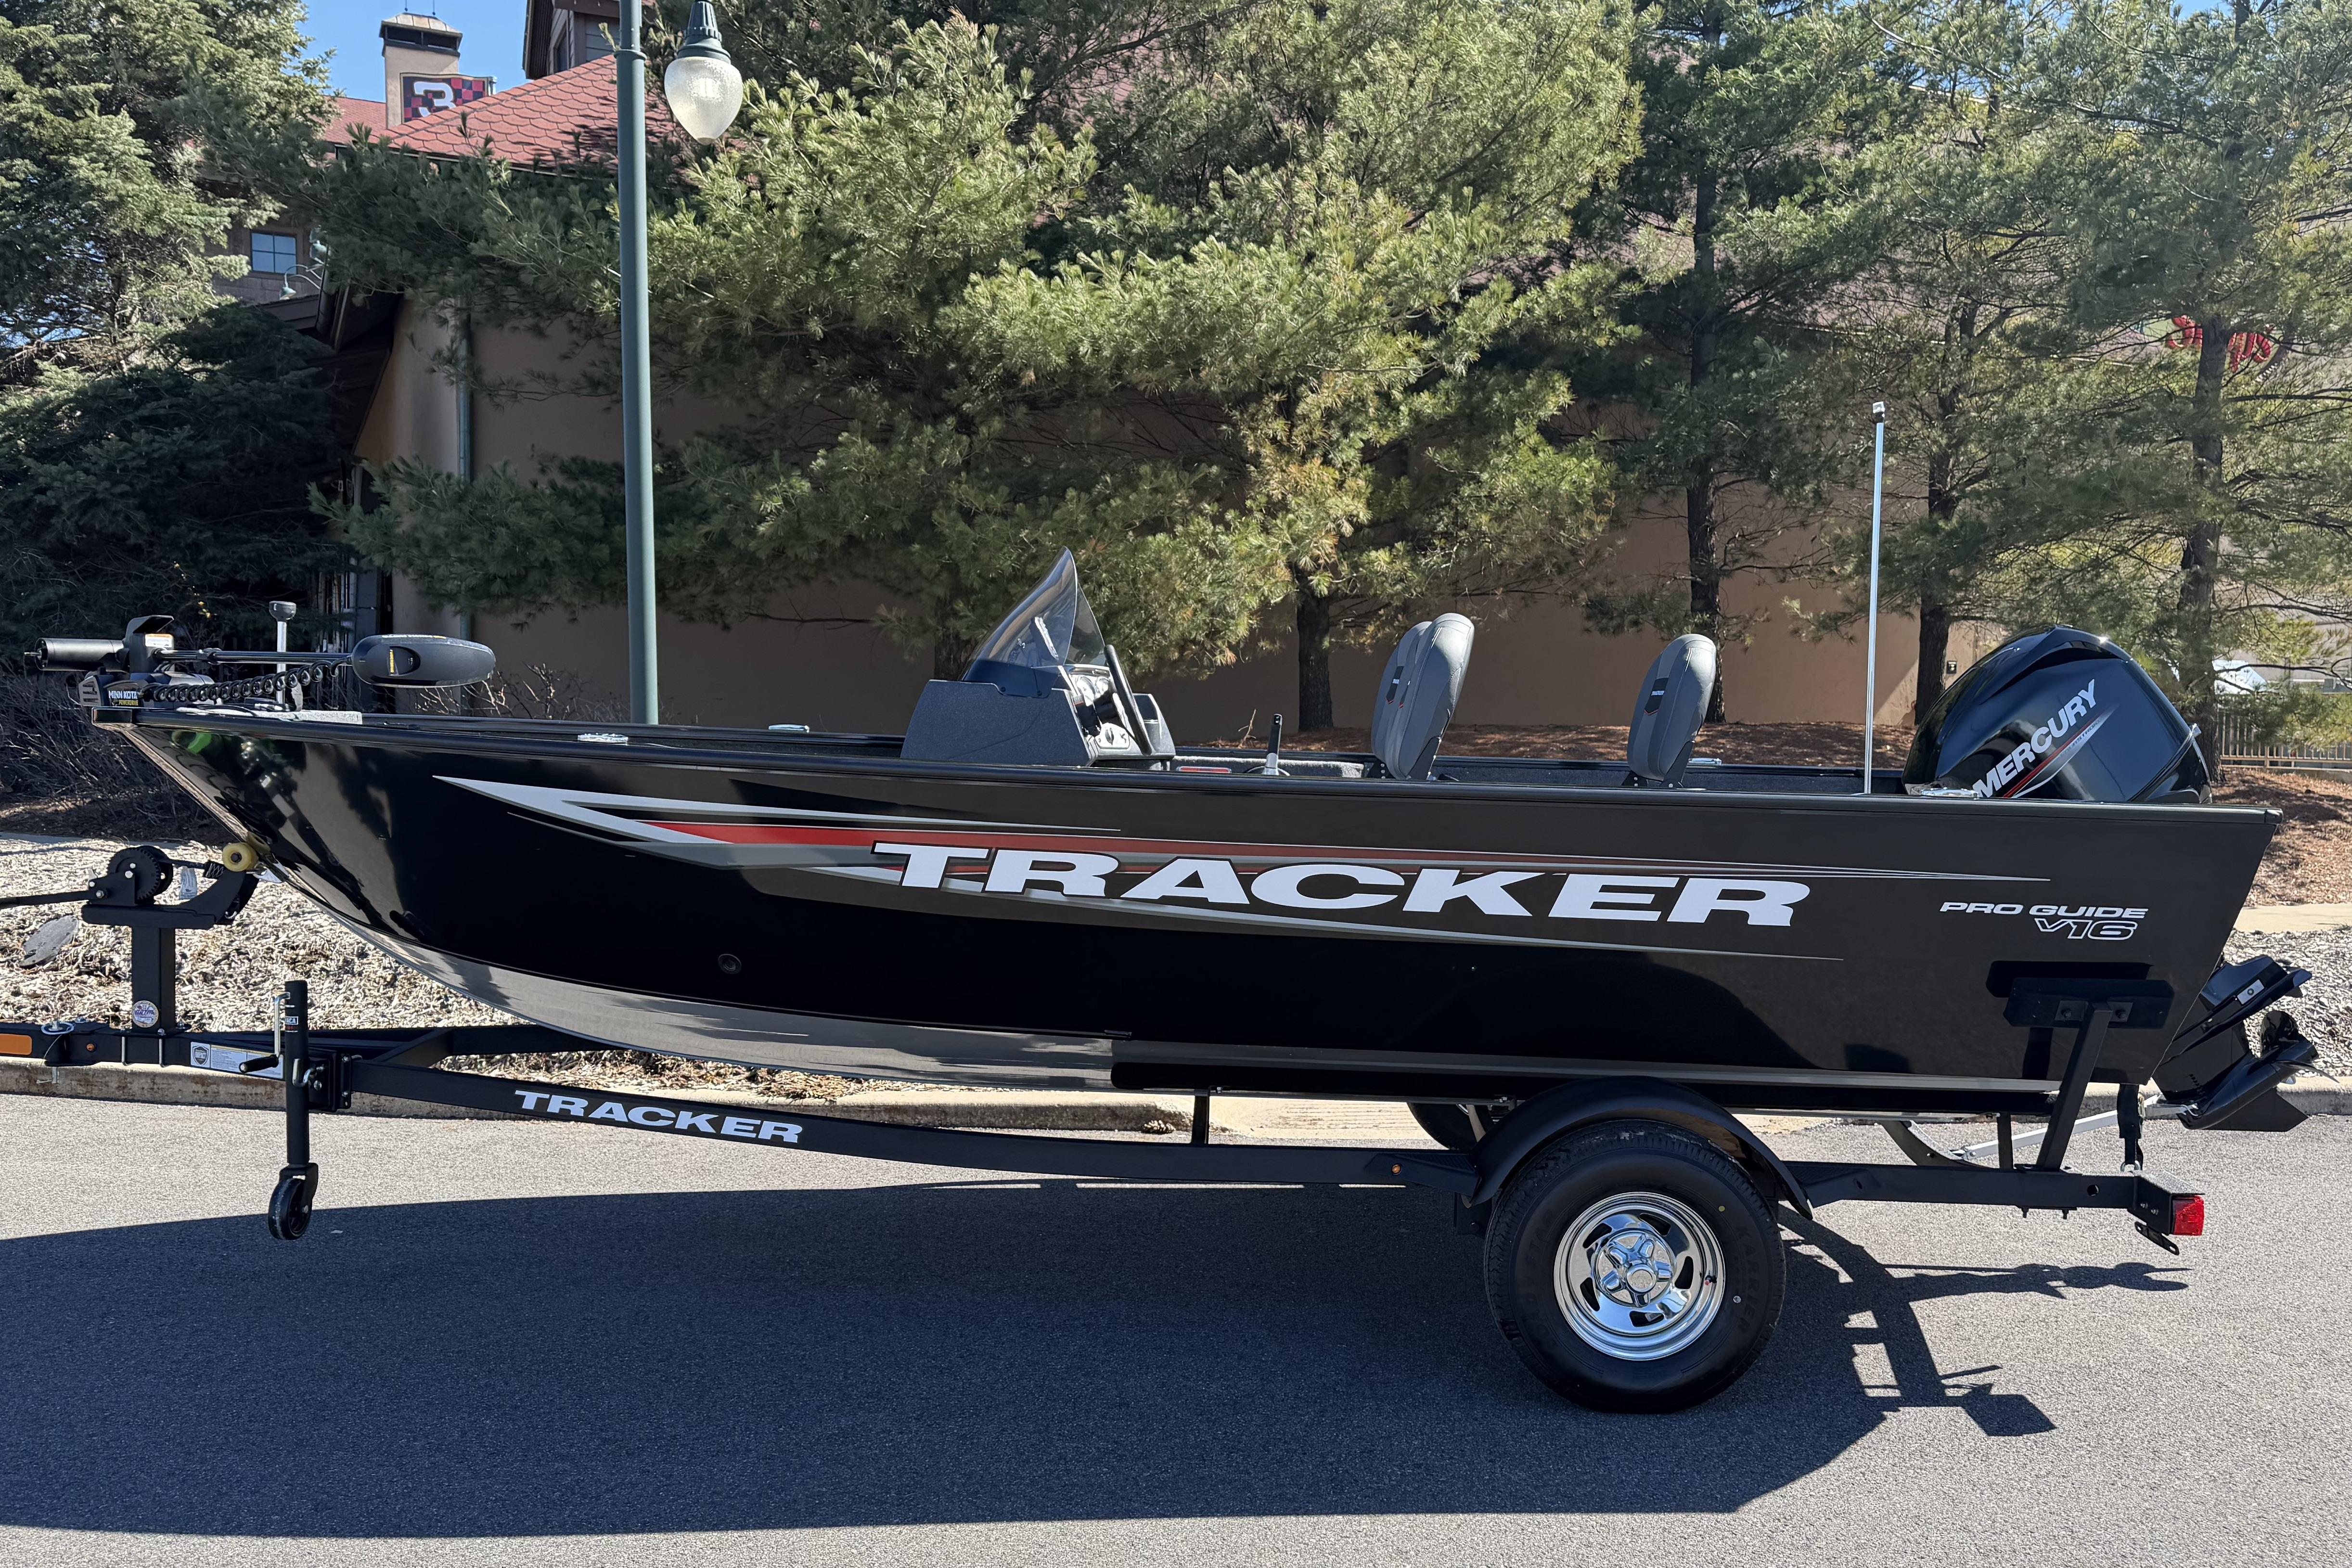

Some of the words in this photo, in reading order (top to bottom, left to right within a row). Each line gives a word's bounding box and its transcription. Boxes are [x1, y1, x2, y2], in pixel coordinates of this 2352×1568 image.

[414, 81, 456, 117] 3
[108, 690, 123, 699] MINN
[124, 691, 138, 699] KOTA
[1972, 679, 2096, 797] MERCURY
[872, 841, 1810, 926] TRACKER
[1940, 902, 2024, 915] PRO
[2029, 905, 2148, 918] GUIDE
[2034, 918, 2138, 940] V16
[515, 1090, 803, 1143] TRACKER
